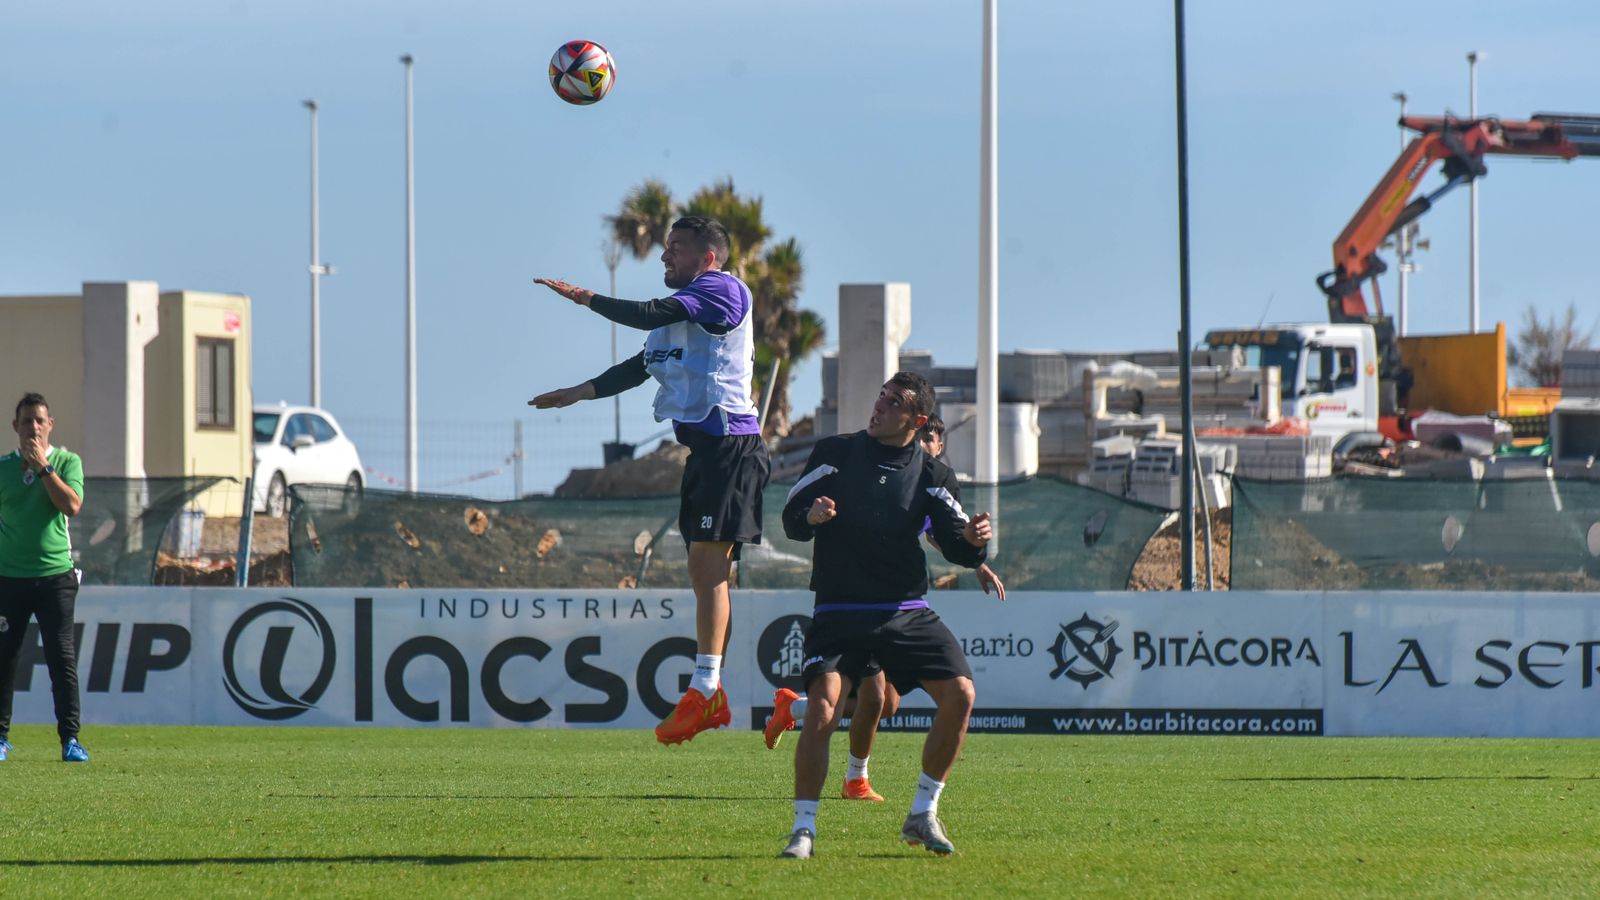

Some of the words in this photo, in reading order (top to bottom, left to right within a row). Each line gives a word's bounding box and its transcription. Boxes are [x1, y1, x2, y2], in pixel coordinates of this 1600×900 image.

[700, 515, 713, 529] 20
[420, 597, 675, 619] INDUSTRIAS
[1133, 630, 1321, 671] BITÁCORA
[1338, 631, 1449, 696] LA
[891, 715, 904, 728] LA
[905, 713, 932, 728] LÍNEA
[968, 713, 1026, 729] ONCEPCIÓN
[1053, 711, 1317, 732] www.barbitacora.com
